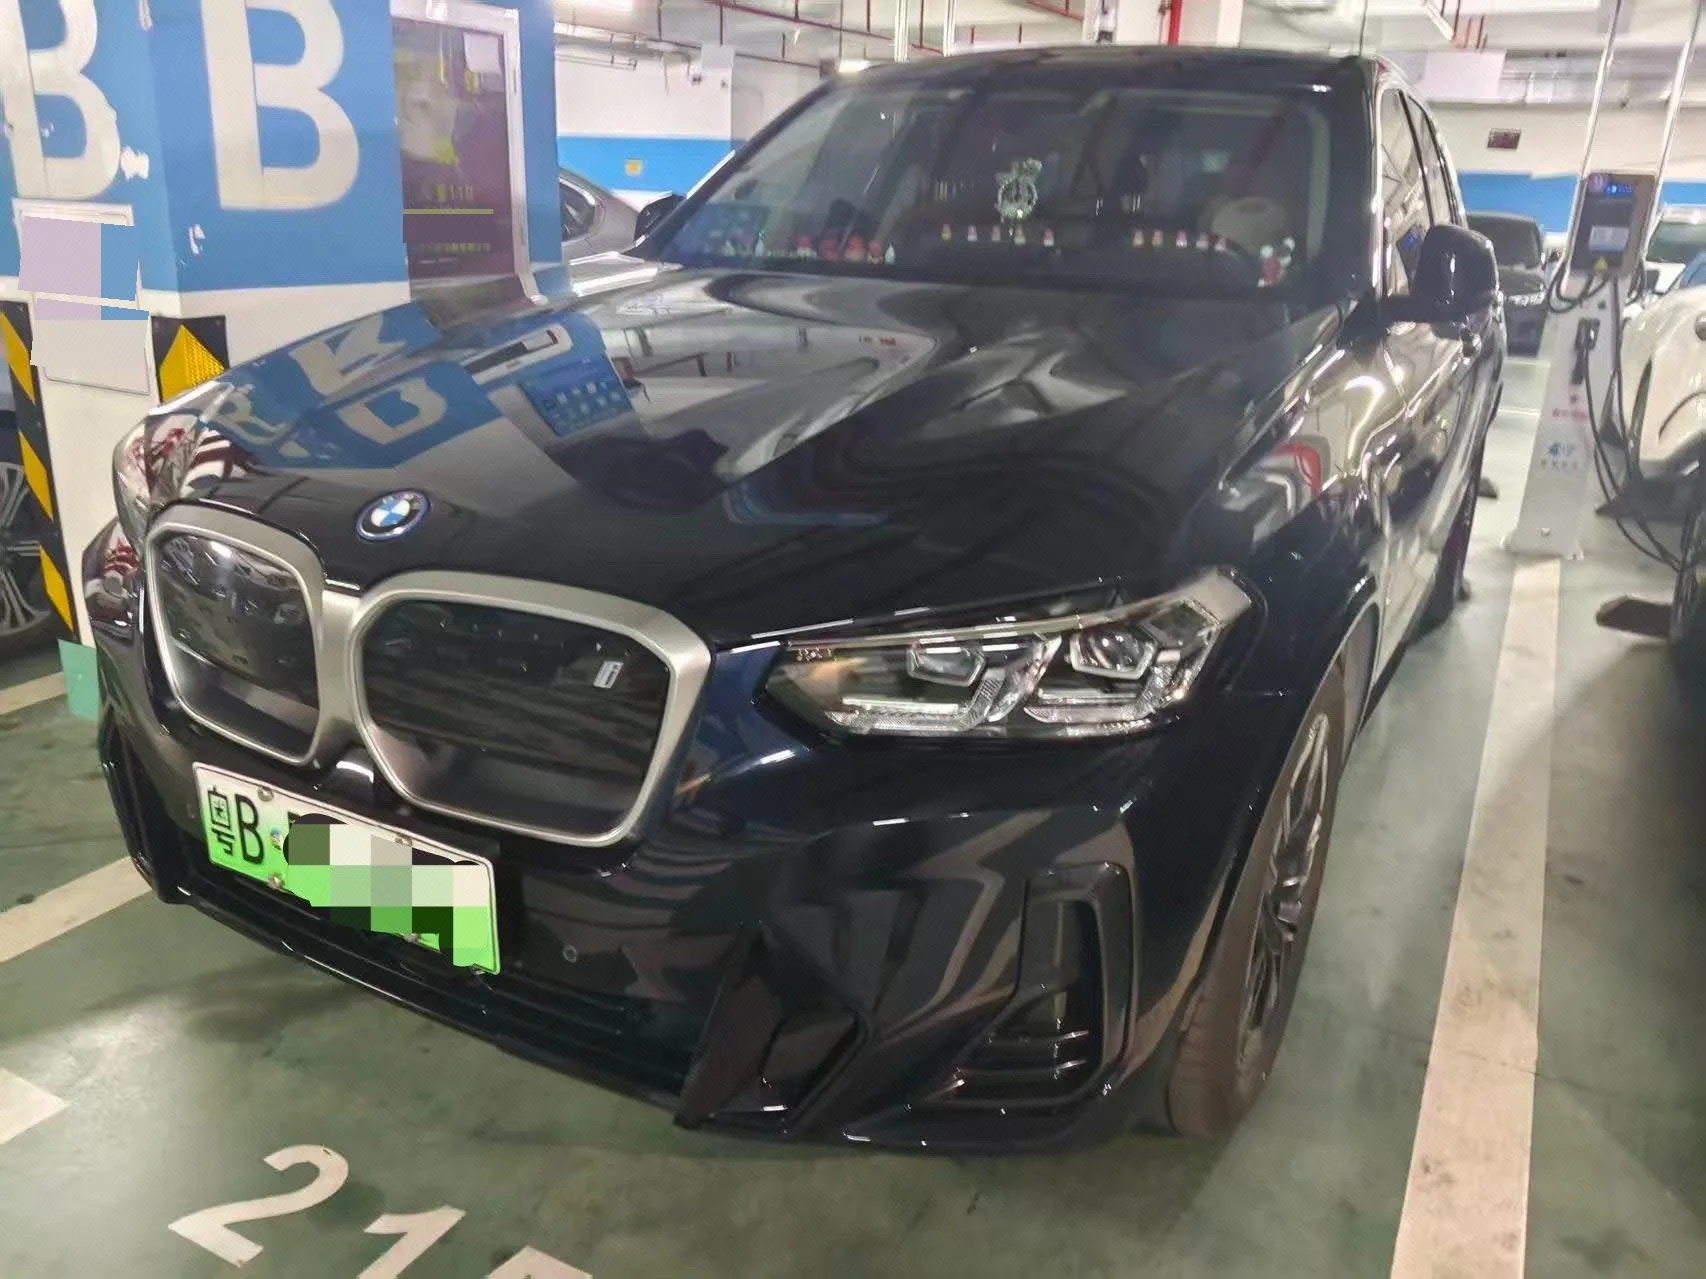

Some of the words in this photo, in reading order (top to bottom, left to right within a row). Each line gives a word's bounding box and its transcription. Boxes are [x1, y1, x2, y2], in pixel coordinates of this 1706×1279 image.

[0, 0, 120, 199] B
[200, 0, 359, 210] B
[168, 1144, 593, 1279] 21
